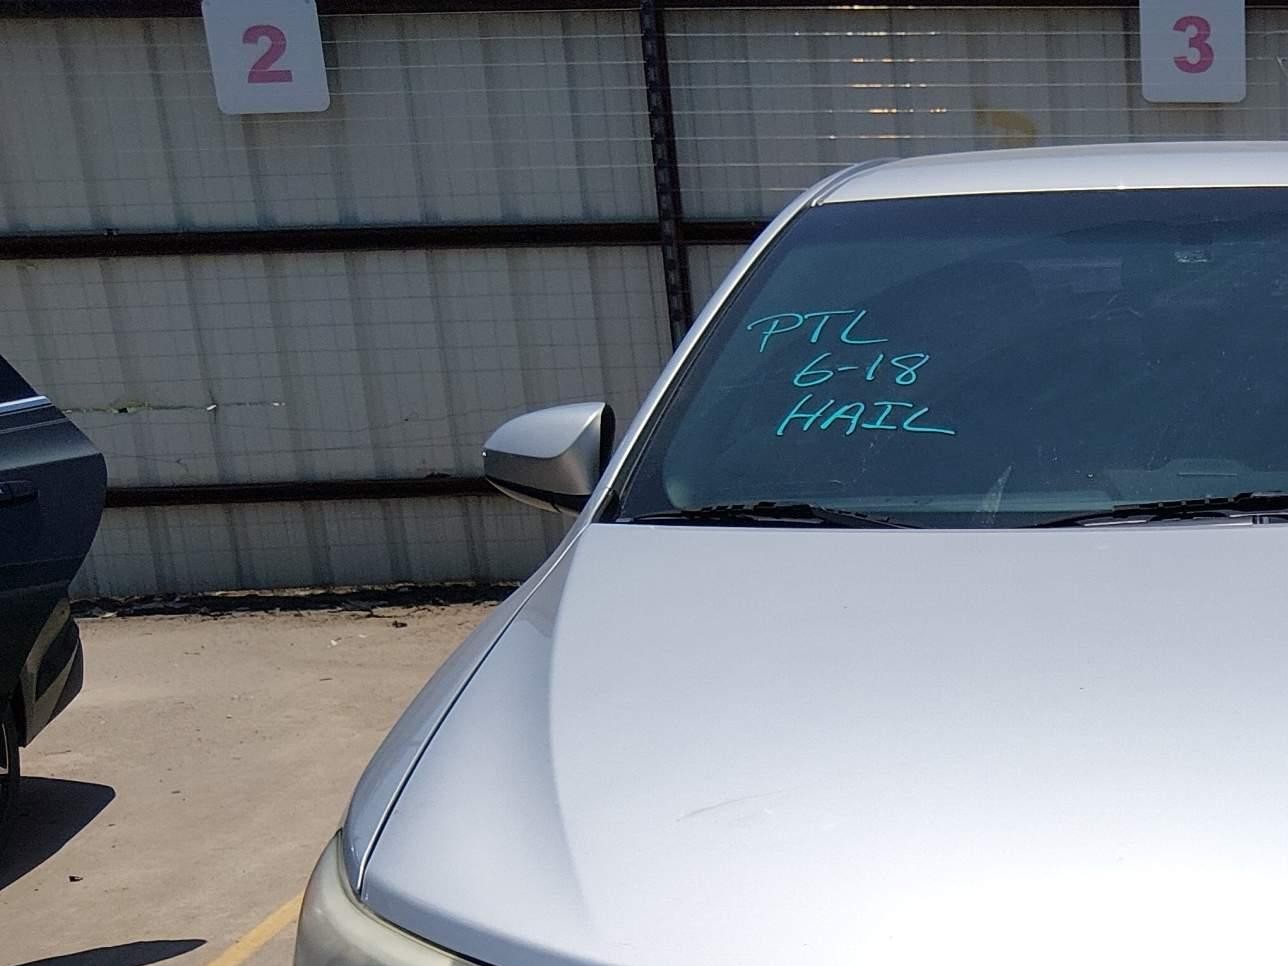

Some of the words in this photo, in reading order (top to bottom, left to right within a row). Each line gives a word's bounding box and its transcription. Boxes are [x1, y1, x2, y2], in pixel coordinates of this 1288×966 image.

[242, 24, 293, 84] 2
[1172, 15, 1214, 74] 3
[746, 309, 889, 352] PTL
[792, 352, 931, 388] 6-18
[776, 393, 956, 436] HAIL
